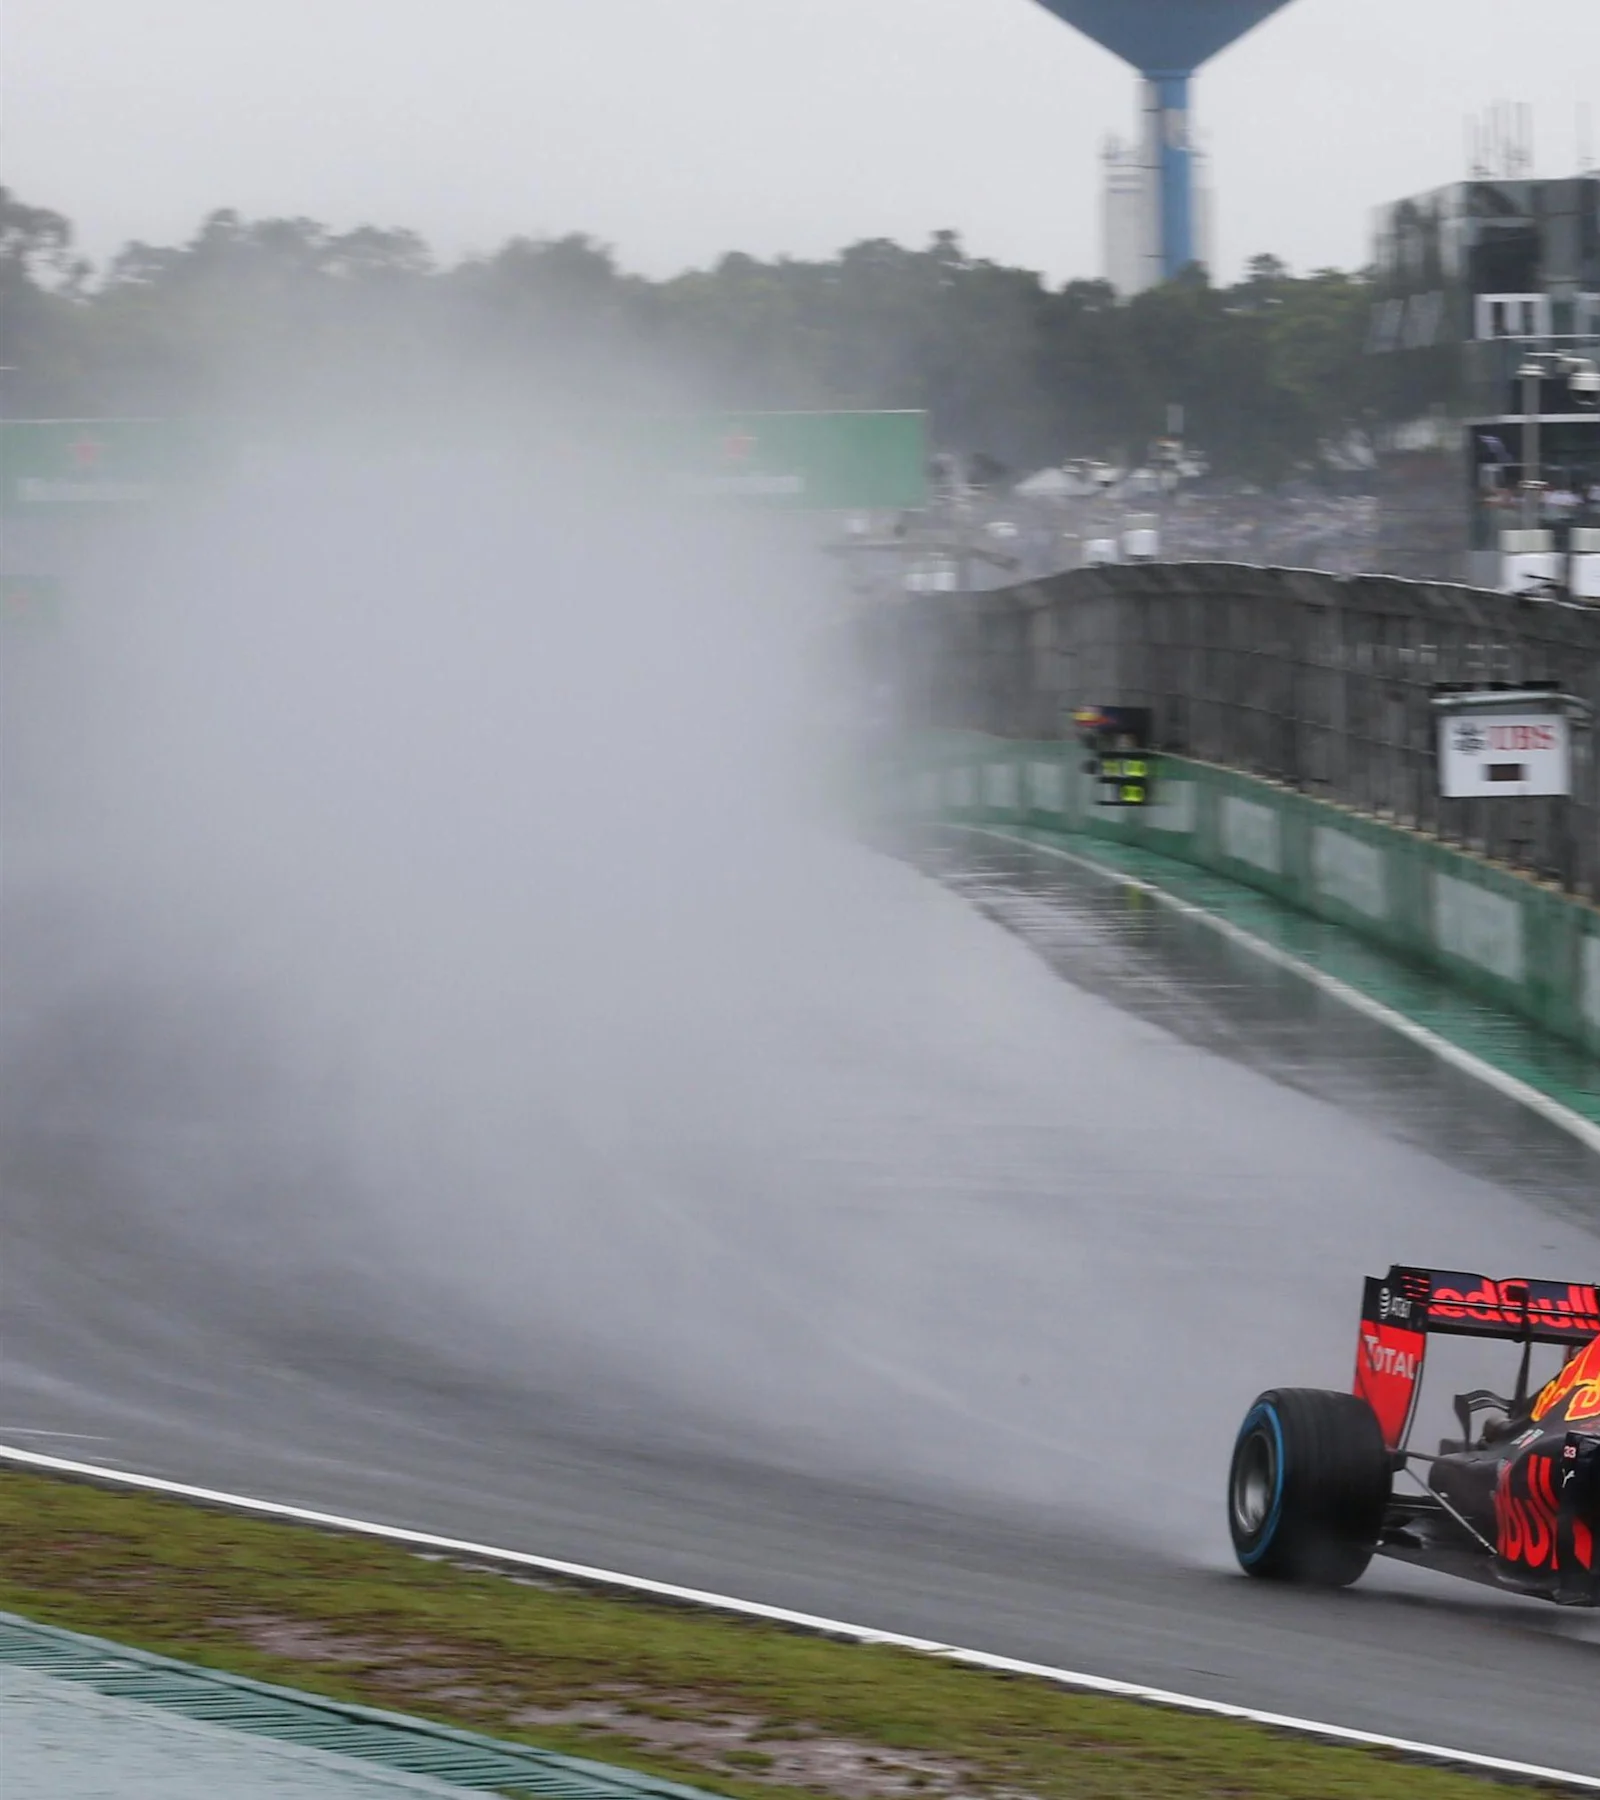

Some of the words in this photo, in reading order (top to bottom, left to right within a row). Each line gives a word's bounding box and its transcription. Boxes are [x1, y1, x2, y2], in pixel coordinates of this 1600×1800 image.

[1488, 724, 1557, 751] UBS
[1363, 1334, 1416, 1380] TOTAL
[1563, 1446, 1577, 1459] 33
